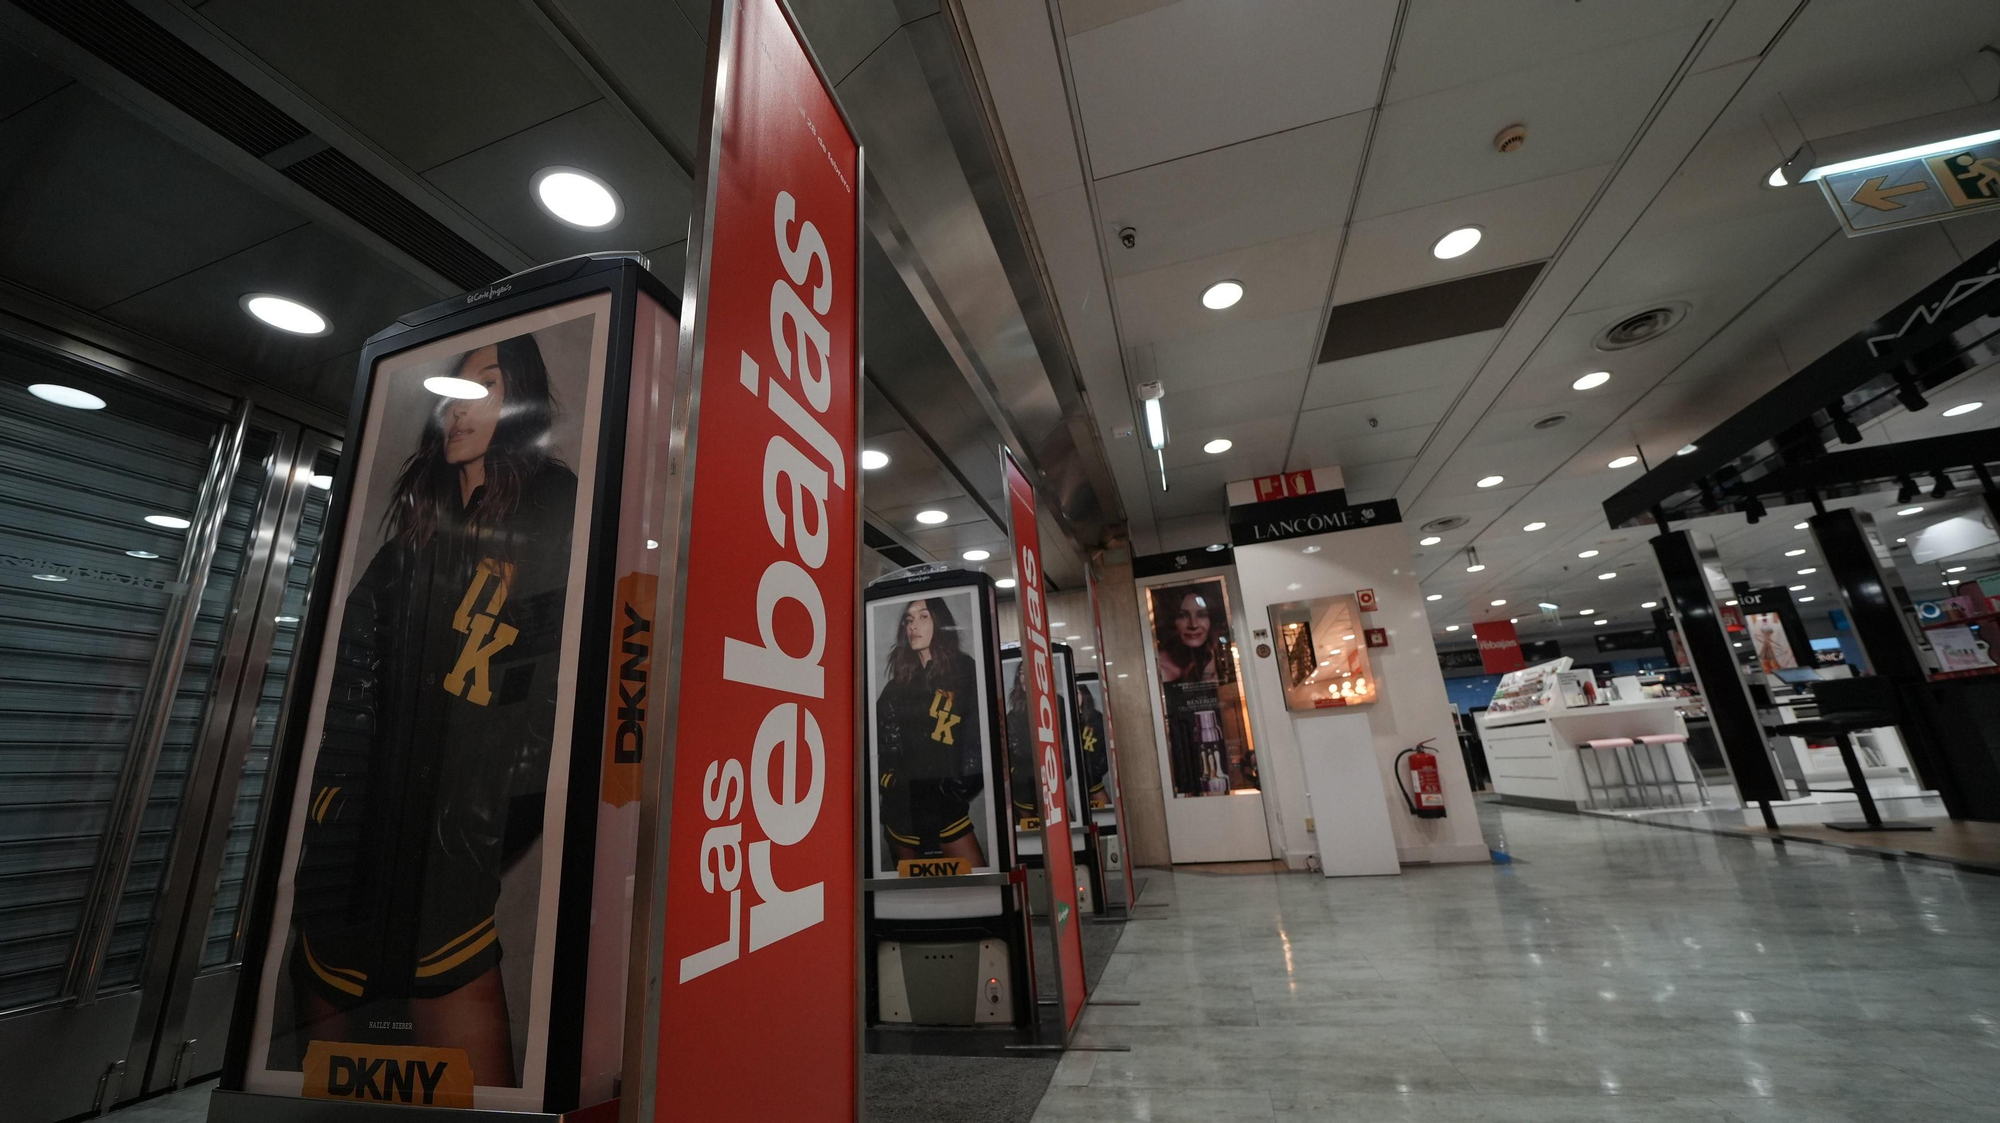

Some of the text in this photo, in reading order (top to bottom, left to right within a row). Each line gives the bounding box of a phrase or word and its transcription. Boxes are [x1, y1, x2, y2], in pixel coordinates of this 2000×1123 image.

[1253, 511, 1355, 539] LANCÔME
[722, 189, 846, 954] rebajas
[1738, 594, 1762, 606] ior
[613, 601, 651, 764] DKNY
[1022, 545, 1062, 825] rebajas
[679, 757, 744, 986] Las
[909, 862, 960, 878] DKNY
[368, 1021, 413, 1030] HAILEY BIEBER
[327, 1054, 449, 1105] DKNY
